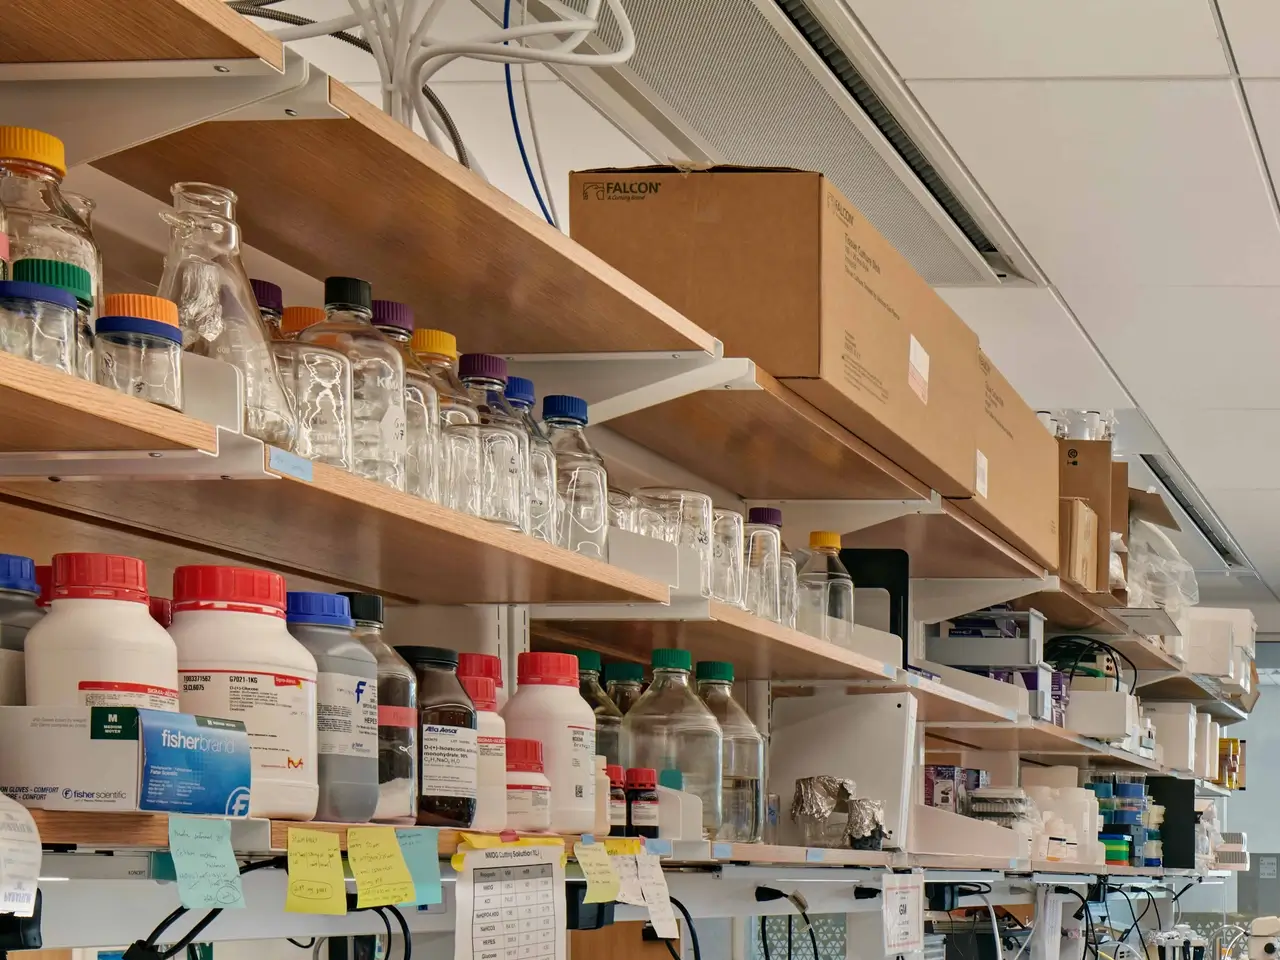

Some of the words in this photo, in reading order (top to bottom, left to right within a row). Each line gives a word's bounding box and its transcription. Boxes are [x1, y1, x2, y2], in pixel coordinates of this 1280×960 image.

[108, 714, 118, 723] M
[161, 729, 235, 754] fisherbrand
[513, 850, 532, 858] Solution
